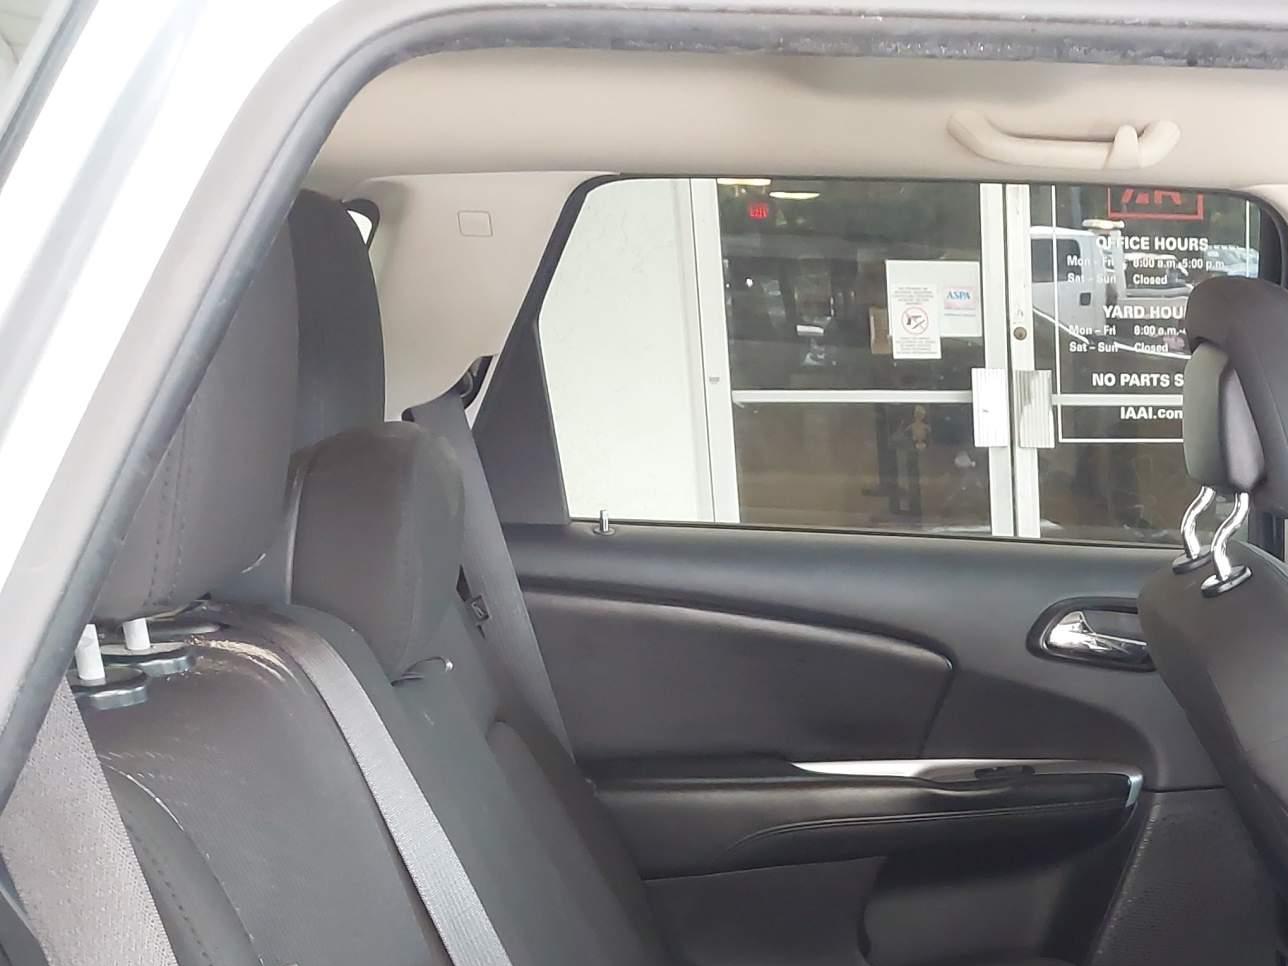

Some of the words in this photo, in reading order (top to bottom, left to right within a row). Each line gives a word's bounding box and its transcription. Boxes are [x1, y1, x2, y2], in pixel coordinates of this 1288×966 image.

[1155, 237, 1208, 251] HOURS
[1067, 255, 1089, 266] Mon
[1133, 273, 1168, 285] Closed
[1103, 305, 1144, 319] YARD
[1150, 305, 1184, 319] HOU
[1104, 325, 1116, 335] Fri
[1069, 342, 1087, 352] Sat
[1098, 342, 1118, 352] Sun
[1134, 342, 1168, 352] Closed
[1092, 373, 1116, 386] NO
[1120, 373, 1170, 387] PARTS
[1174, 374, 1184, 387] S
